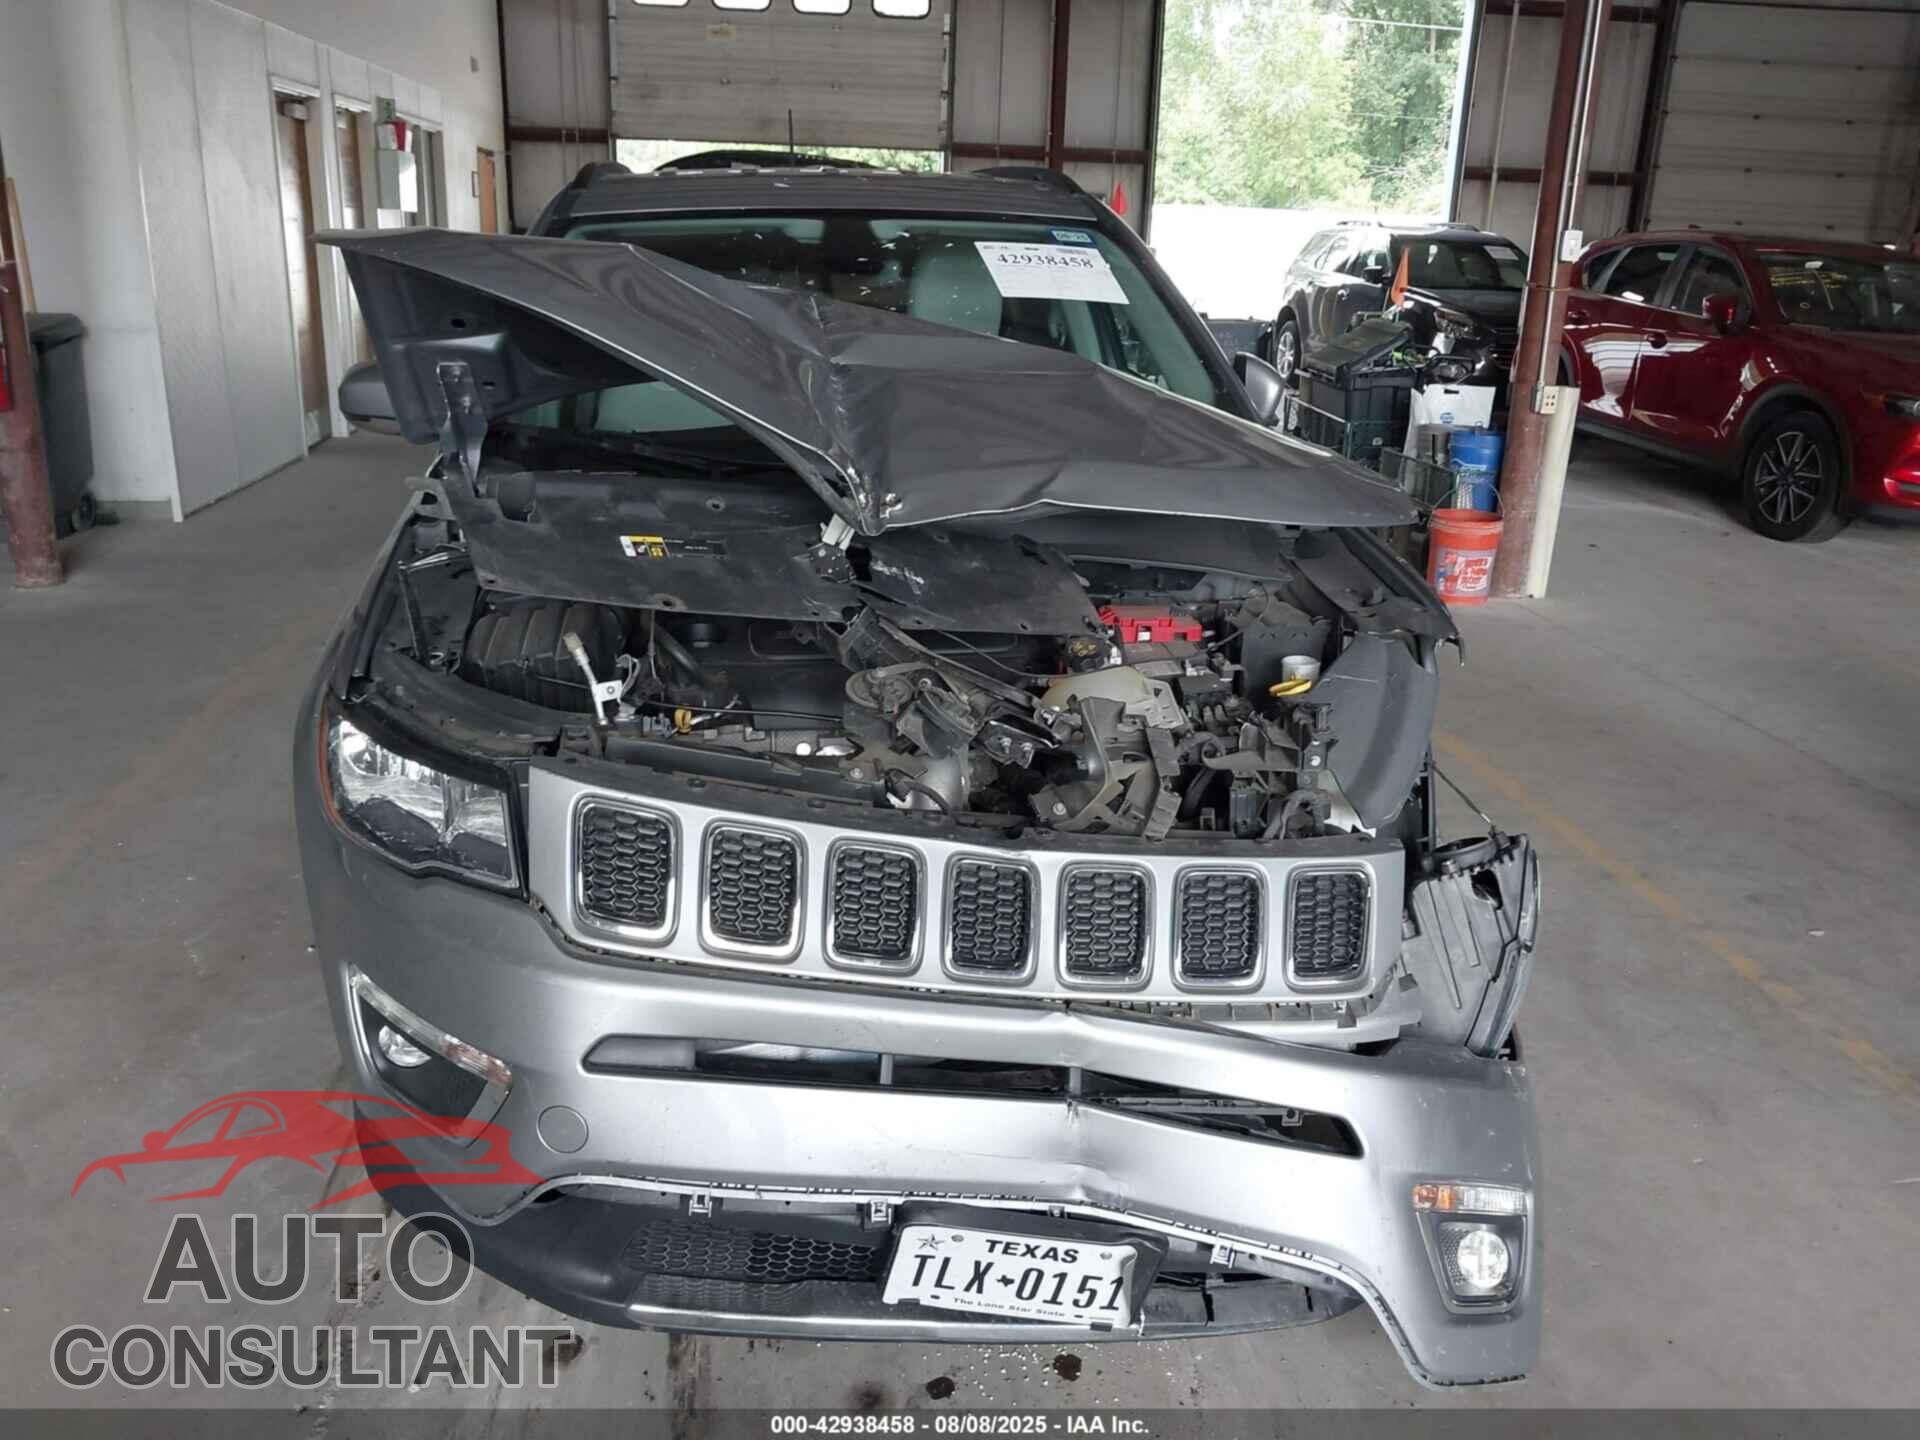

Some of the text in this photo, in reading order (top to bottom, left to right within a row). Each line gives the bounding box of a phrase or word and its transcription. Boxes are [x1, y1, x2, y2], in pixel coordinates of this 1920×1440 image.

[997, 253, 1094, 269] 42938458
[985, 1239, 1080, 1264] TEXAS
[911, 1254, 1124, 1311] TLX 0151
[953, 1297, 1067, 1317] The Lone Star State
